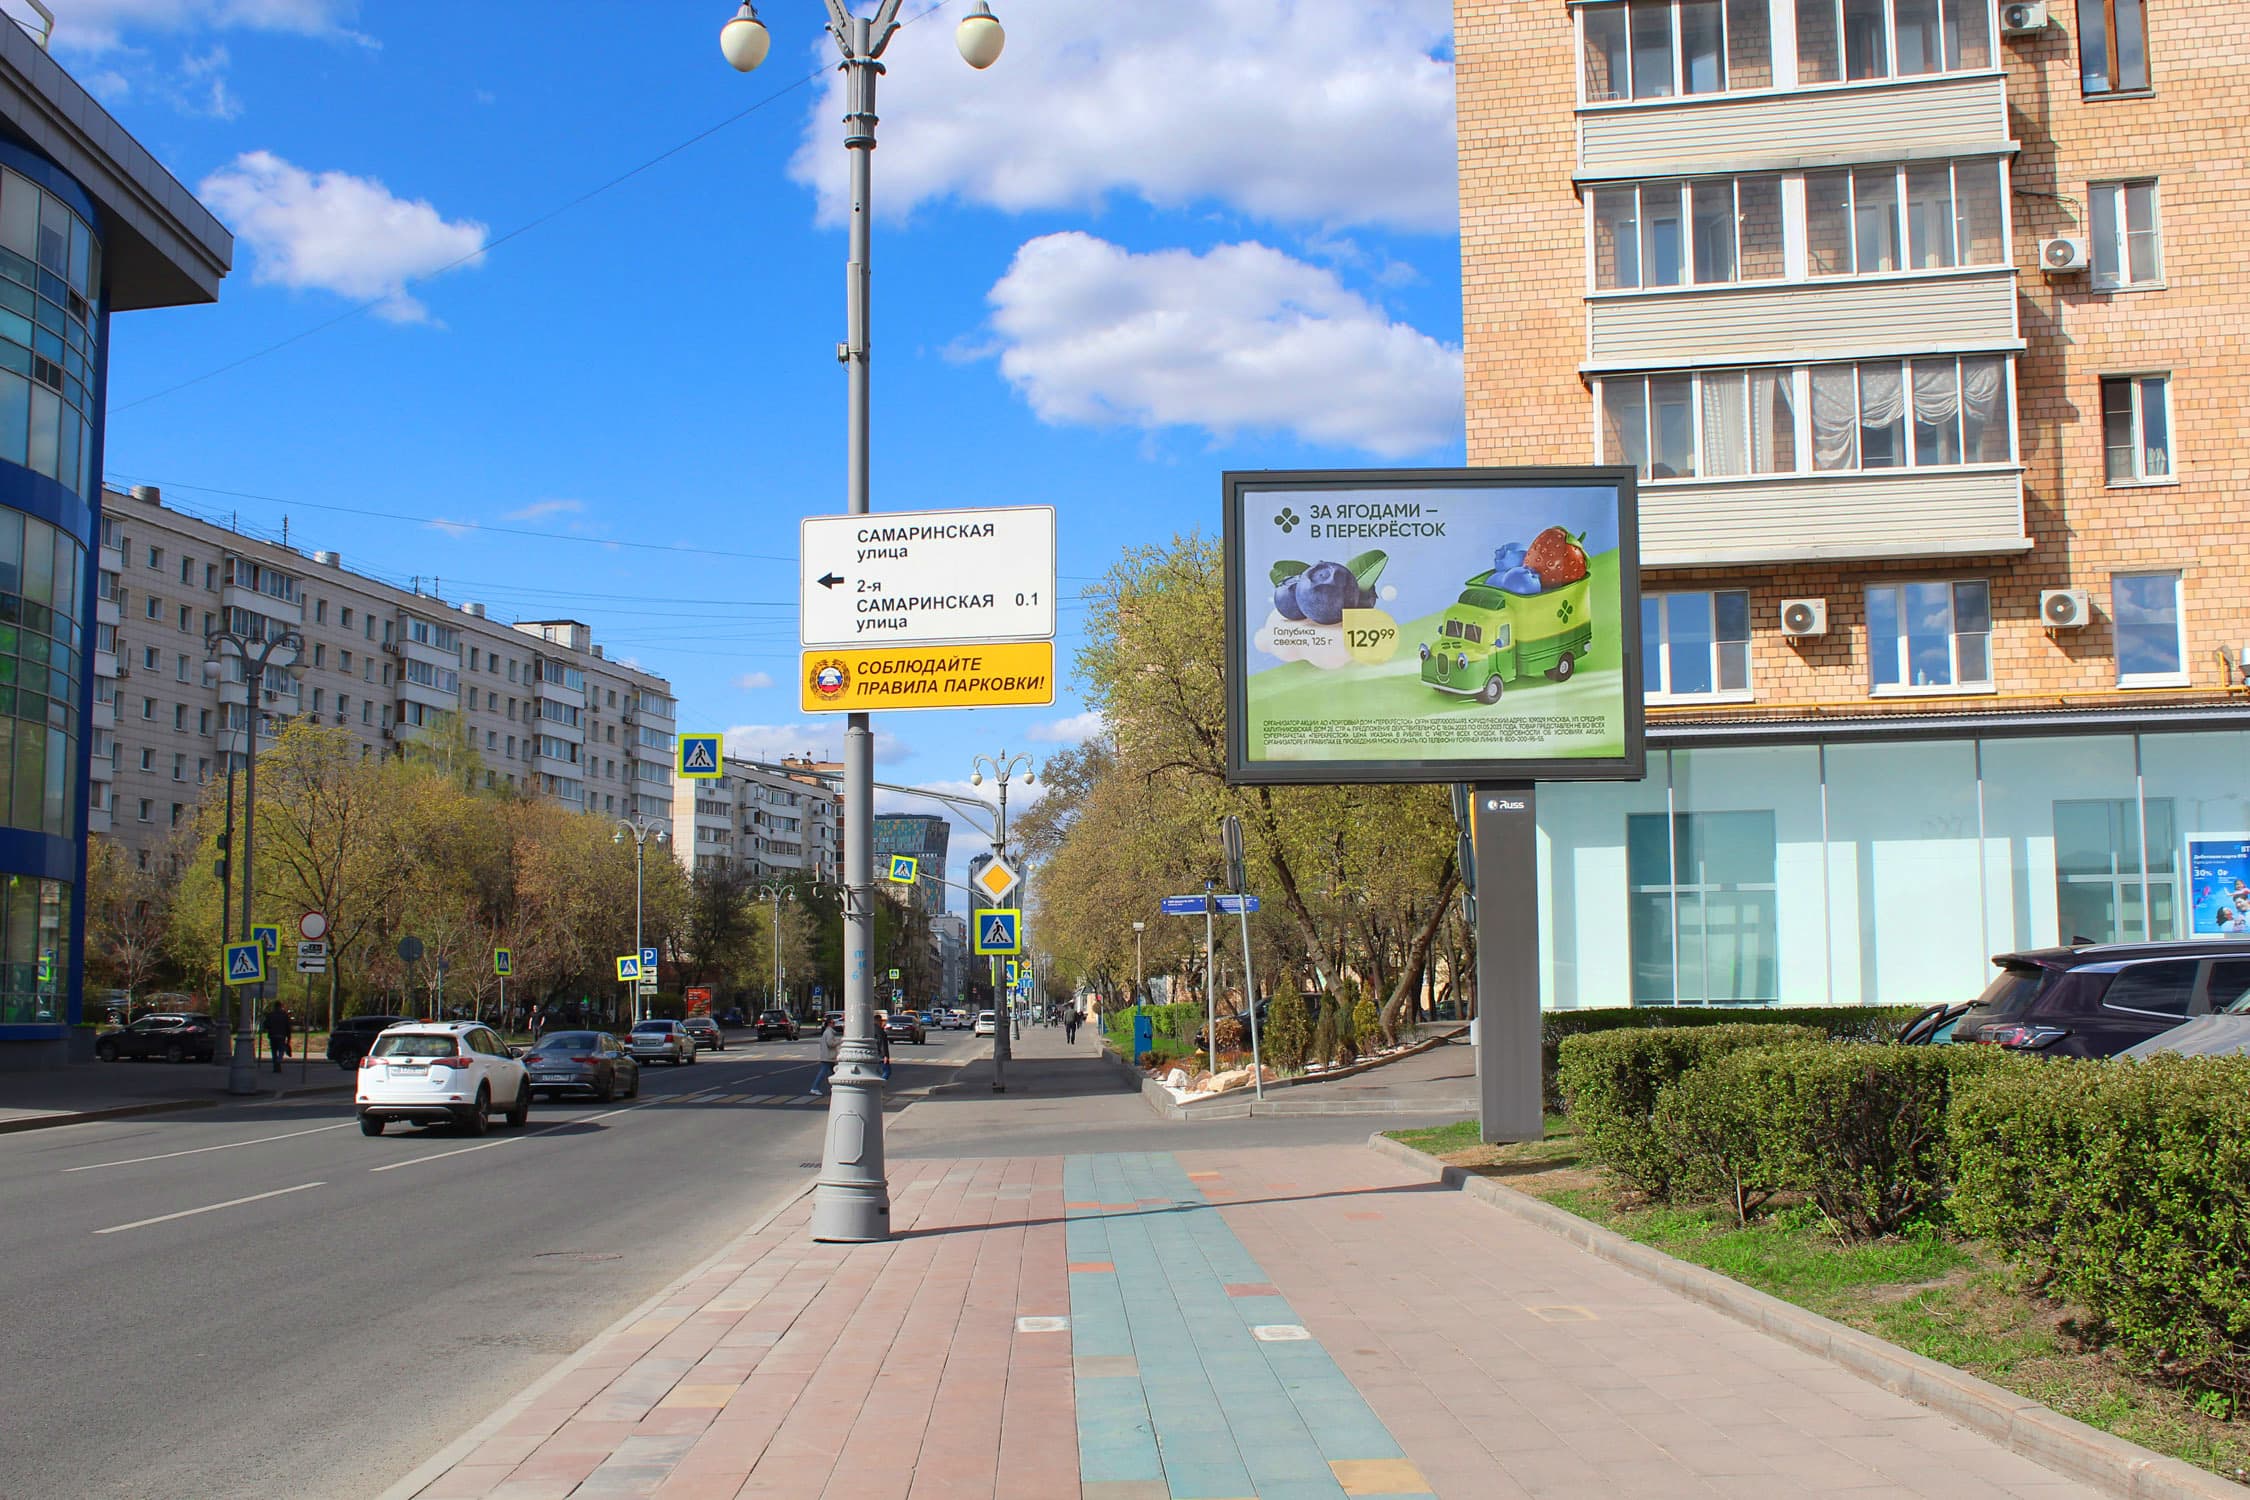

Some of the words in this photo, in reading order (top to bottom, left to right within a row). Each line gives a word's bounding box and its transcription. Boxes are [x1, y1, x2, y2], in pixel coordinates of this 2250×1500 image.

[1310, 505, 1332, 519] ЗА
[1336, 503, 1420, 520] ЯГОДАМИ
[857, 523, 995, 543] САМАРИНСКАЯ
[1311, 524, 1321, 538] В
[1326, 521, 1446, 538] ПЕРЕКРЁСТОК
[856, 546, 908, 563] улица
[857, 579, 881, 593] 2-я
[856, 594, 994, 613] САМАРИНСКАЯ
[1015, 592, 1038, 607] 0.1
[856, 617, 907, 633] улица
[1273, 627, 1316, 637] Голубика
[1311, 637, 1326, 646] 125
[857, 656, 982, 676] СОБЛЮДАЙТЕ
[856, 680, 938, 696] ПРАВИЛА
[943, 676, 1045, 693] ПАРКОВКИ!
